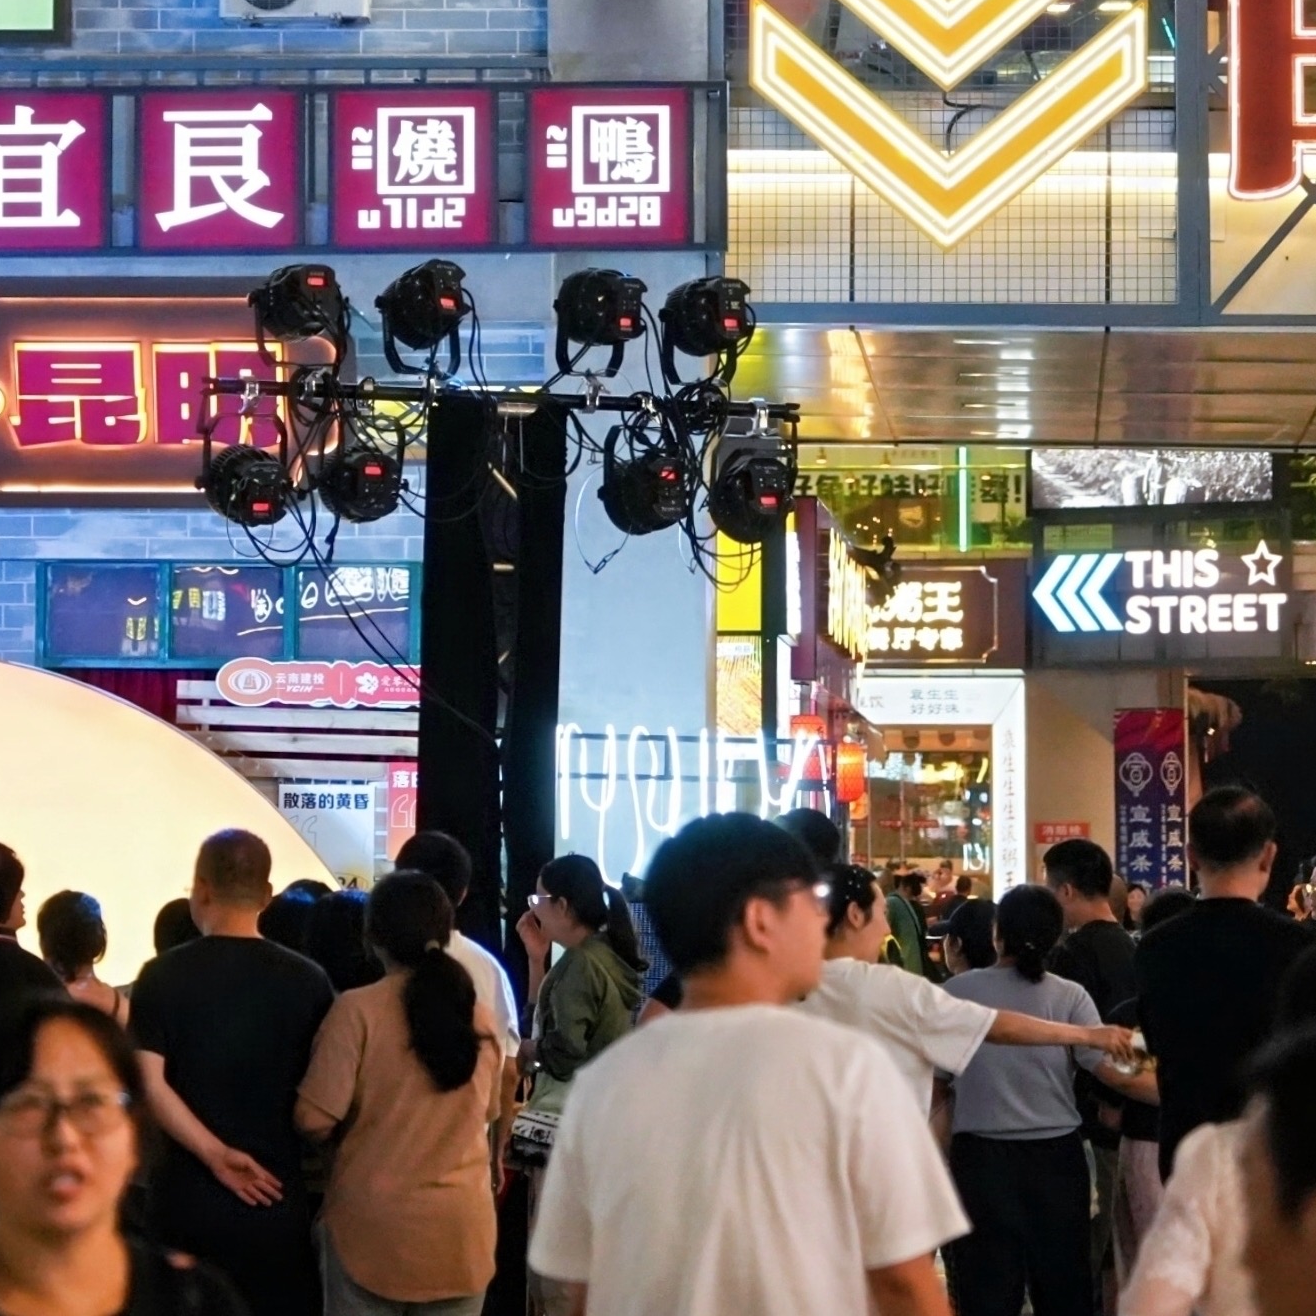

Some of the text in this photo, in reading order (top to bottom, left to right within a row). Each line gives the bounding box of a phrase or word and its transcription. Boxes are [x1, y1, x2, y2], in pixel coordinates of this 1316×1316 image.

[1124, 550, 1220, 588] THIS
[1125, 593, 1288, 634] STREET
[284, 792, 370, 810] 散落的黄昏
